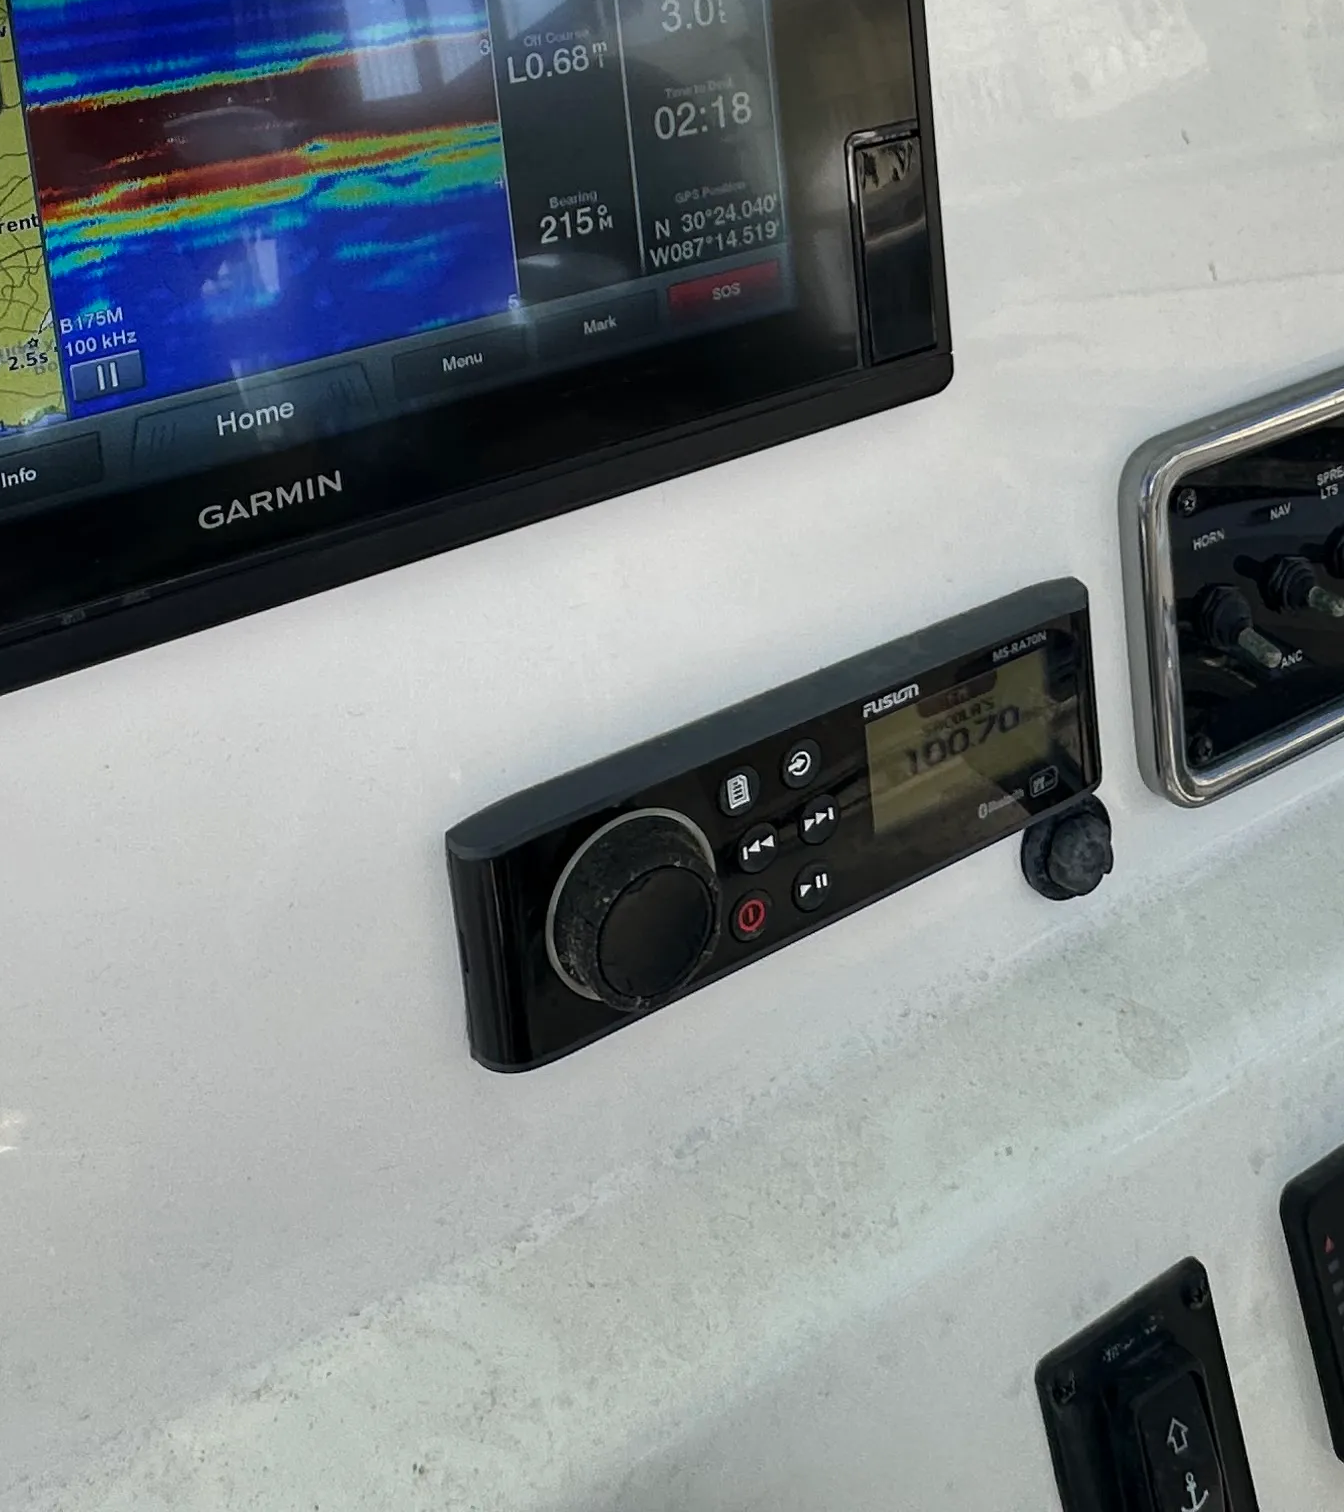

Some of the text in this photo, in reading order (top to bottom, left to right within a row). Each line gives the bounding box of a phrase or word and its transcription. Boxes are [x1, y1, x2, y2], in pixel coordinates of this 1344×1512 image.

[654, 90, 754, 140] 02:18
[548, 189, 599, 210] Bearing
[539, 207, 594, 244] 215
[654, 218, 671, 240] N
[711, 281, 741, 301] SOS
[583, 314, 618, 336] Mark
[64, 335, 99, 358] 100
[101, 328, 138, 351] kHz
[7, 349, 50, 372] 2.5s
[441, 349, 484, 373] Menu
[216, 400, 296, 437] Home
[0, 465, 38, 488] Info
[197, 469, 344, 530] GARMIN
[1319, 482, 1338, 501] LTS
[1269, 501, 1292, 521] NAV
[1192, 528, 1225, 551] HORN
[1280, 650, 1304, 669] ANC
[862, 682, 920, 719] FUSION
